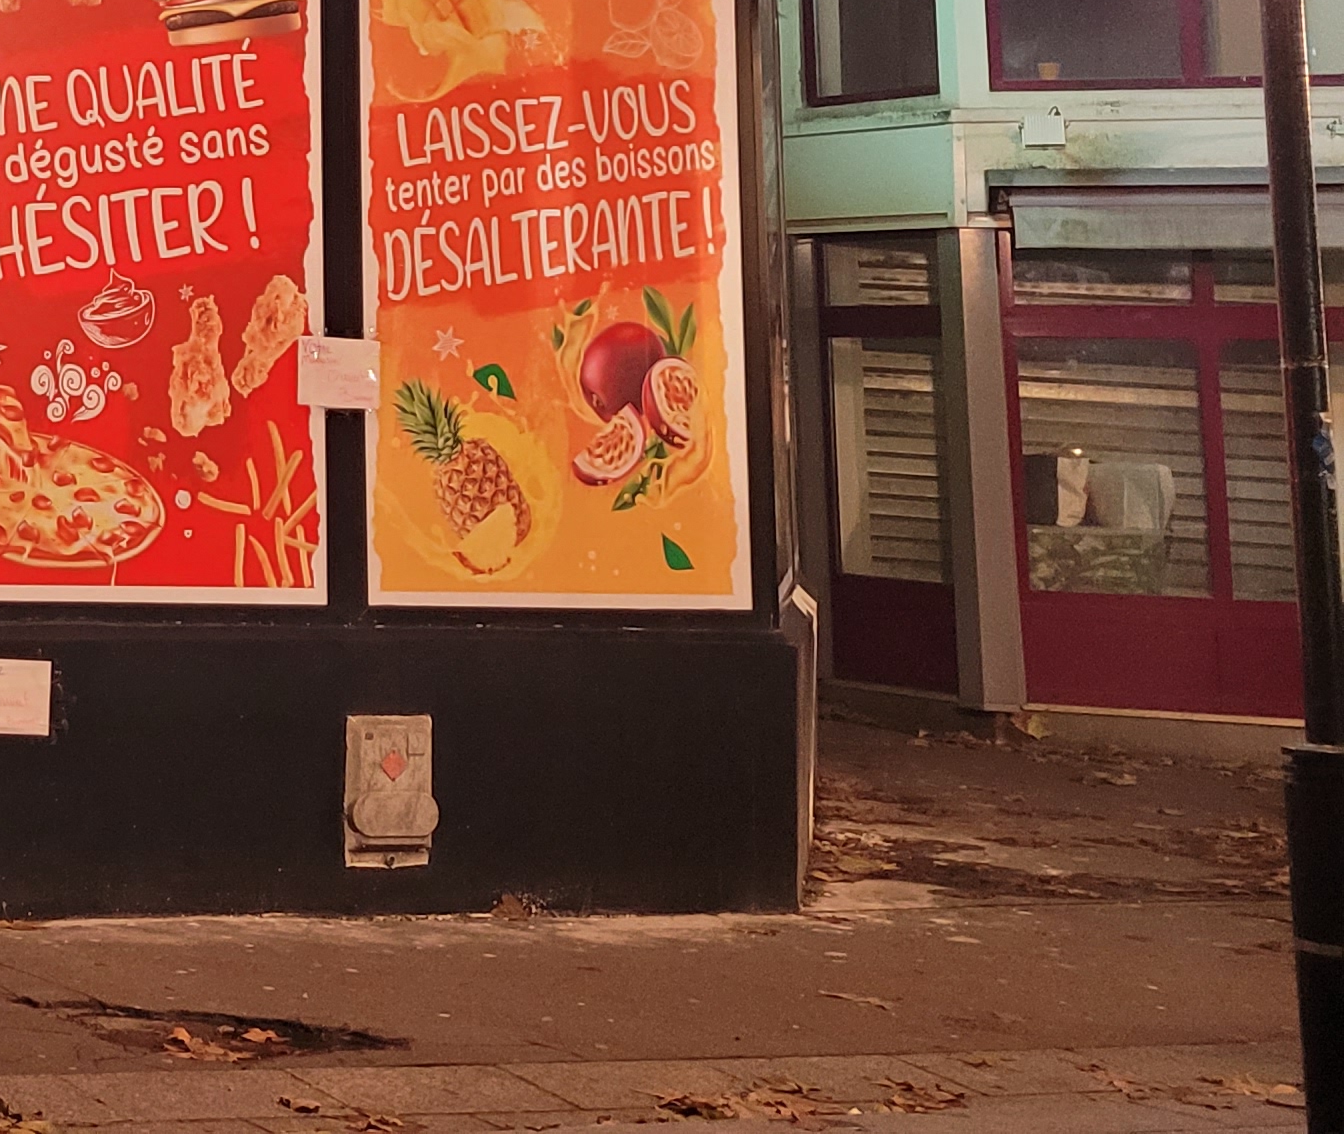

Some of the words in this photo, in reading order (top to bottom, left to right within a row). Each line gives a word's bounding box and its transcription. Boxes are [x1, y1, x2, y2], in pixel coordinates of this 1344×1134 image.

[66, 37, 265, 128] QUALITÉ
[397, 79, 698, 167] LAISSEZ-VOUS
[4, 125, 165, 189] dégusté
[179, 123, 271, 165] sans
[385, 171, 472, 213] tenter
[481, 166, 526, 208] par
[536, 154, 587, 192] des
[595, 140, 715, 183] boissons
[384, 190, 696, 301] DÉSALTERANTE
